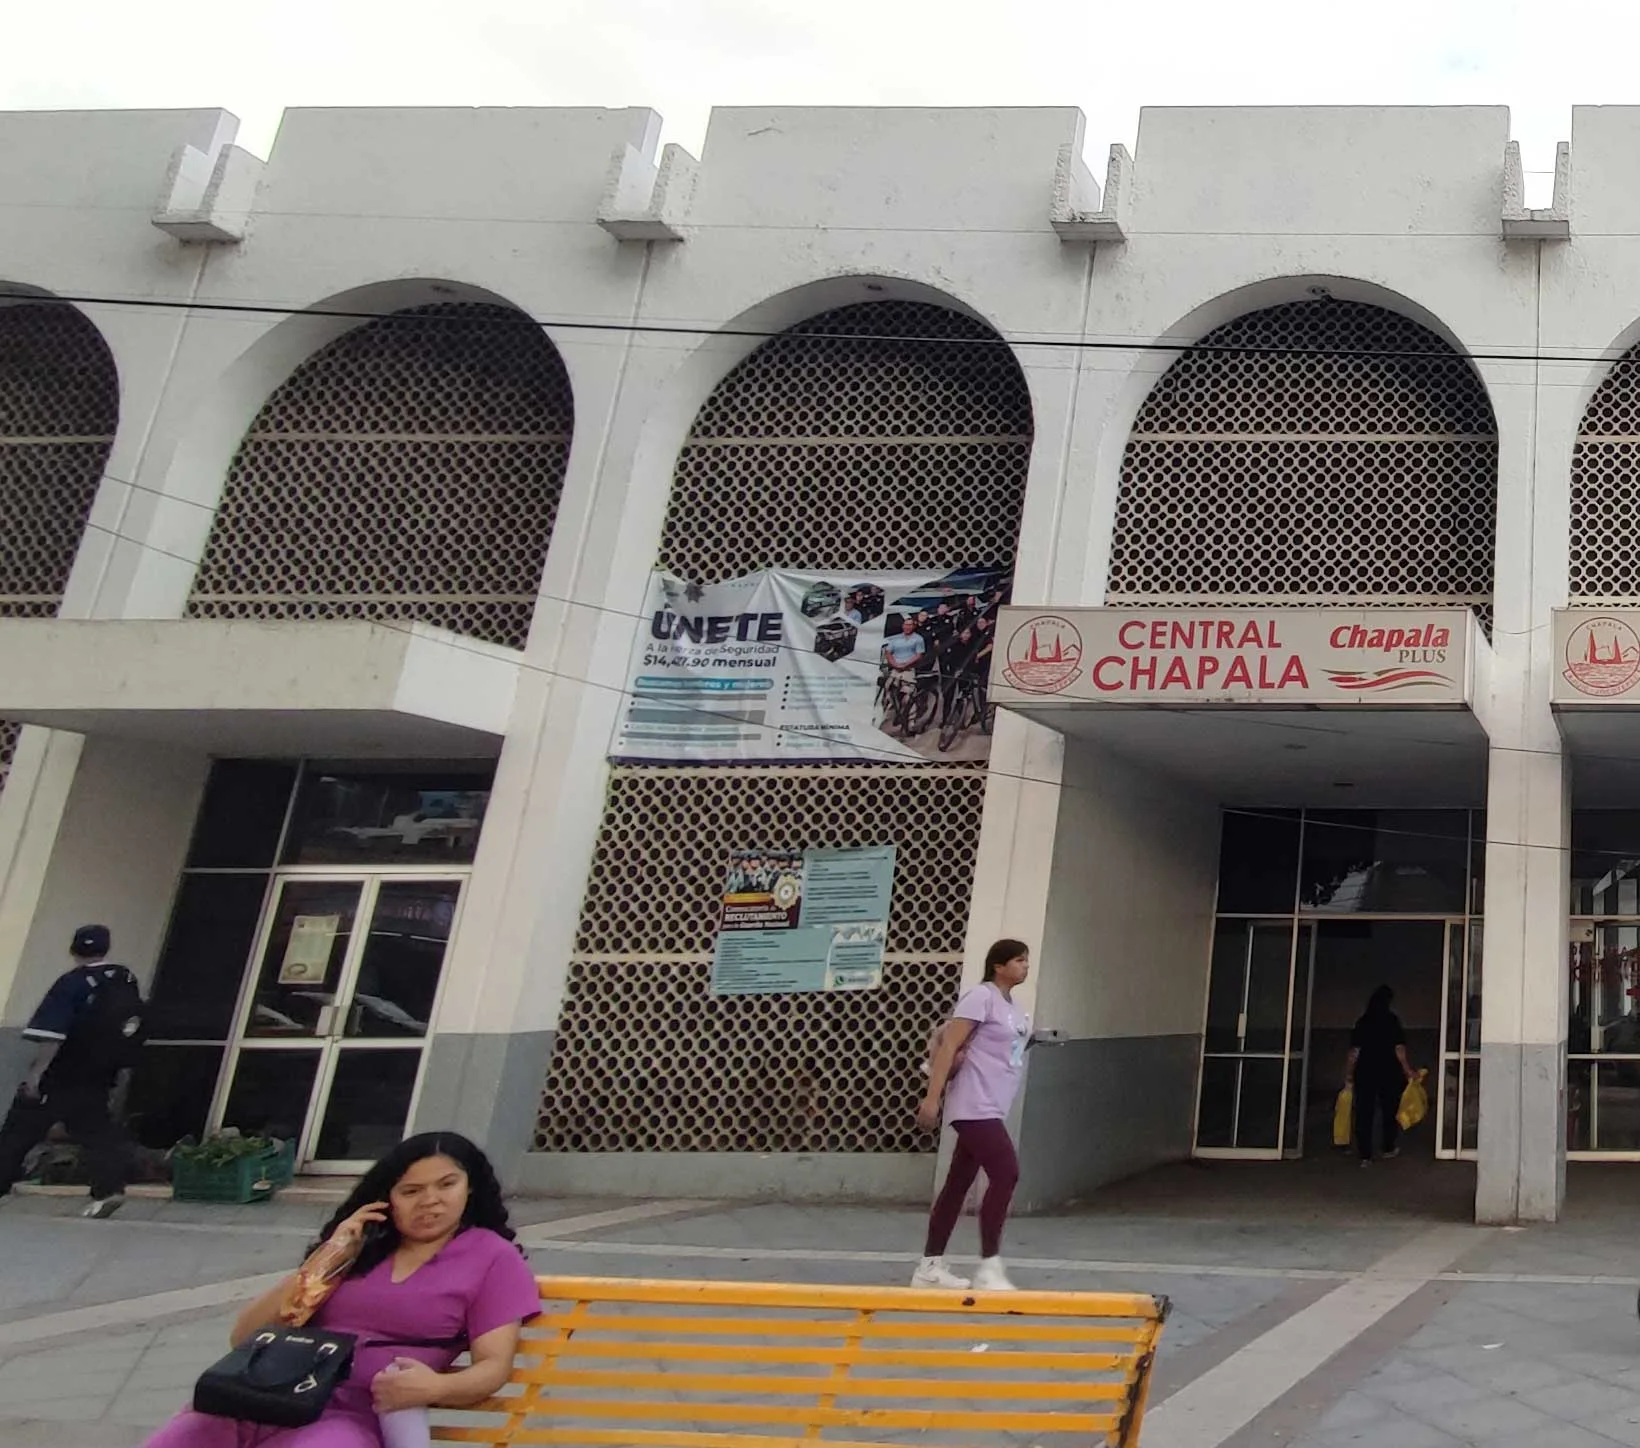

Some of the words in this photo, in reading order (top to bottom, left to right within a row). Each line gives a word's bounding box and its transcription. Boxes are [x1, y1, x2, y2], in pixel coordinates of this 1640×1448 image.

[1118, 620, 1282, 650] CENTRAL
[1329, 623, 1450, 652] Chapala
[645, 643, 655, 652] A
[719, 642, 780, 657] Seguridad
[1398, 649, 1446, 663] PLUS
[711, 656, 777, 668] mensual
[1092, 655, 1309, 691] CHAPALA
